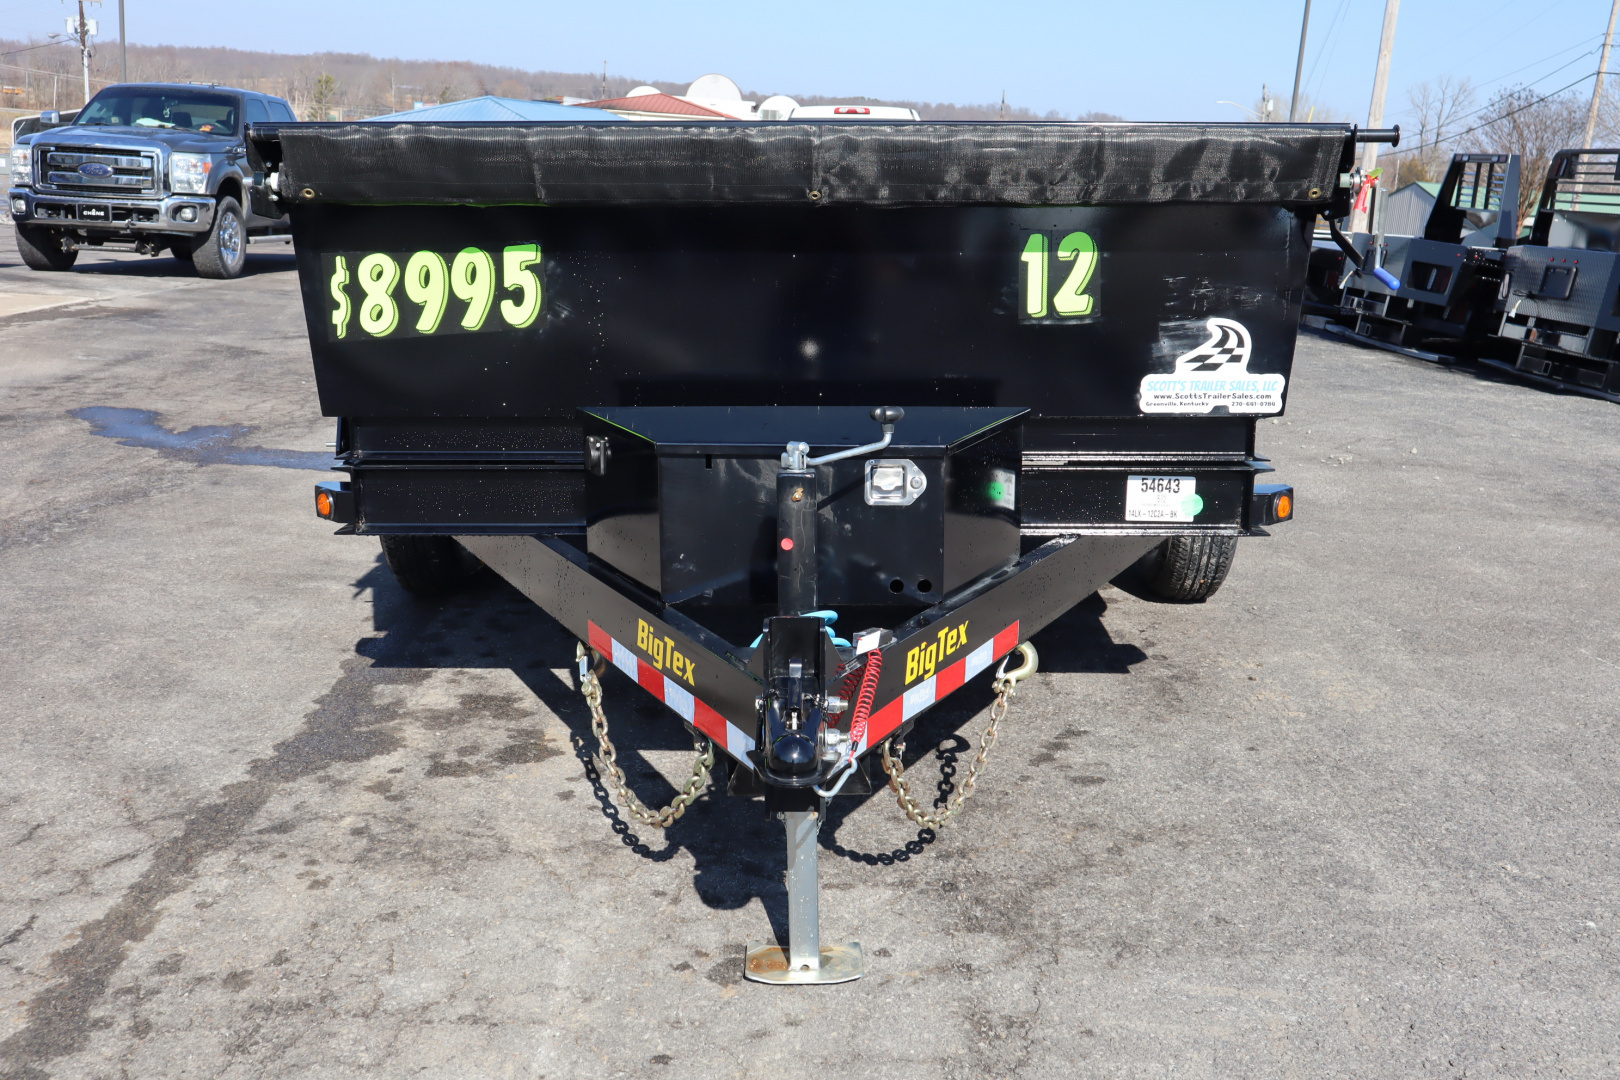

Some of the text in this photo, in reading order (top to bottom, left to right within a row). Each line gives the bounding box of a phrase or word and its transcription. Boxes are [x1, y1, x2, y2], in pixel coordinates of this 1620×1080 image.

[330, 243, 541, 339] $8995
[1021, 231, 1098, 318] 12
[1147, 380, 1279, 393] SCOTT'S TRAILER SALES, LLC
[1153, 392, 1272, 400] www.ScottsTrailerSales.com
[1141, 477, 1180, 493] 54643
[637, 618, 696, 687] BigTex
[904, 620, 969, 686] BigTex
